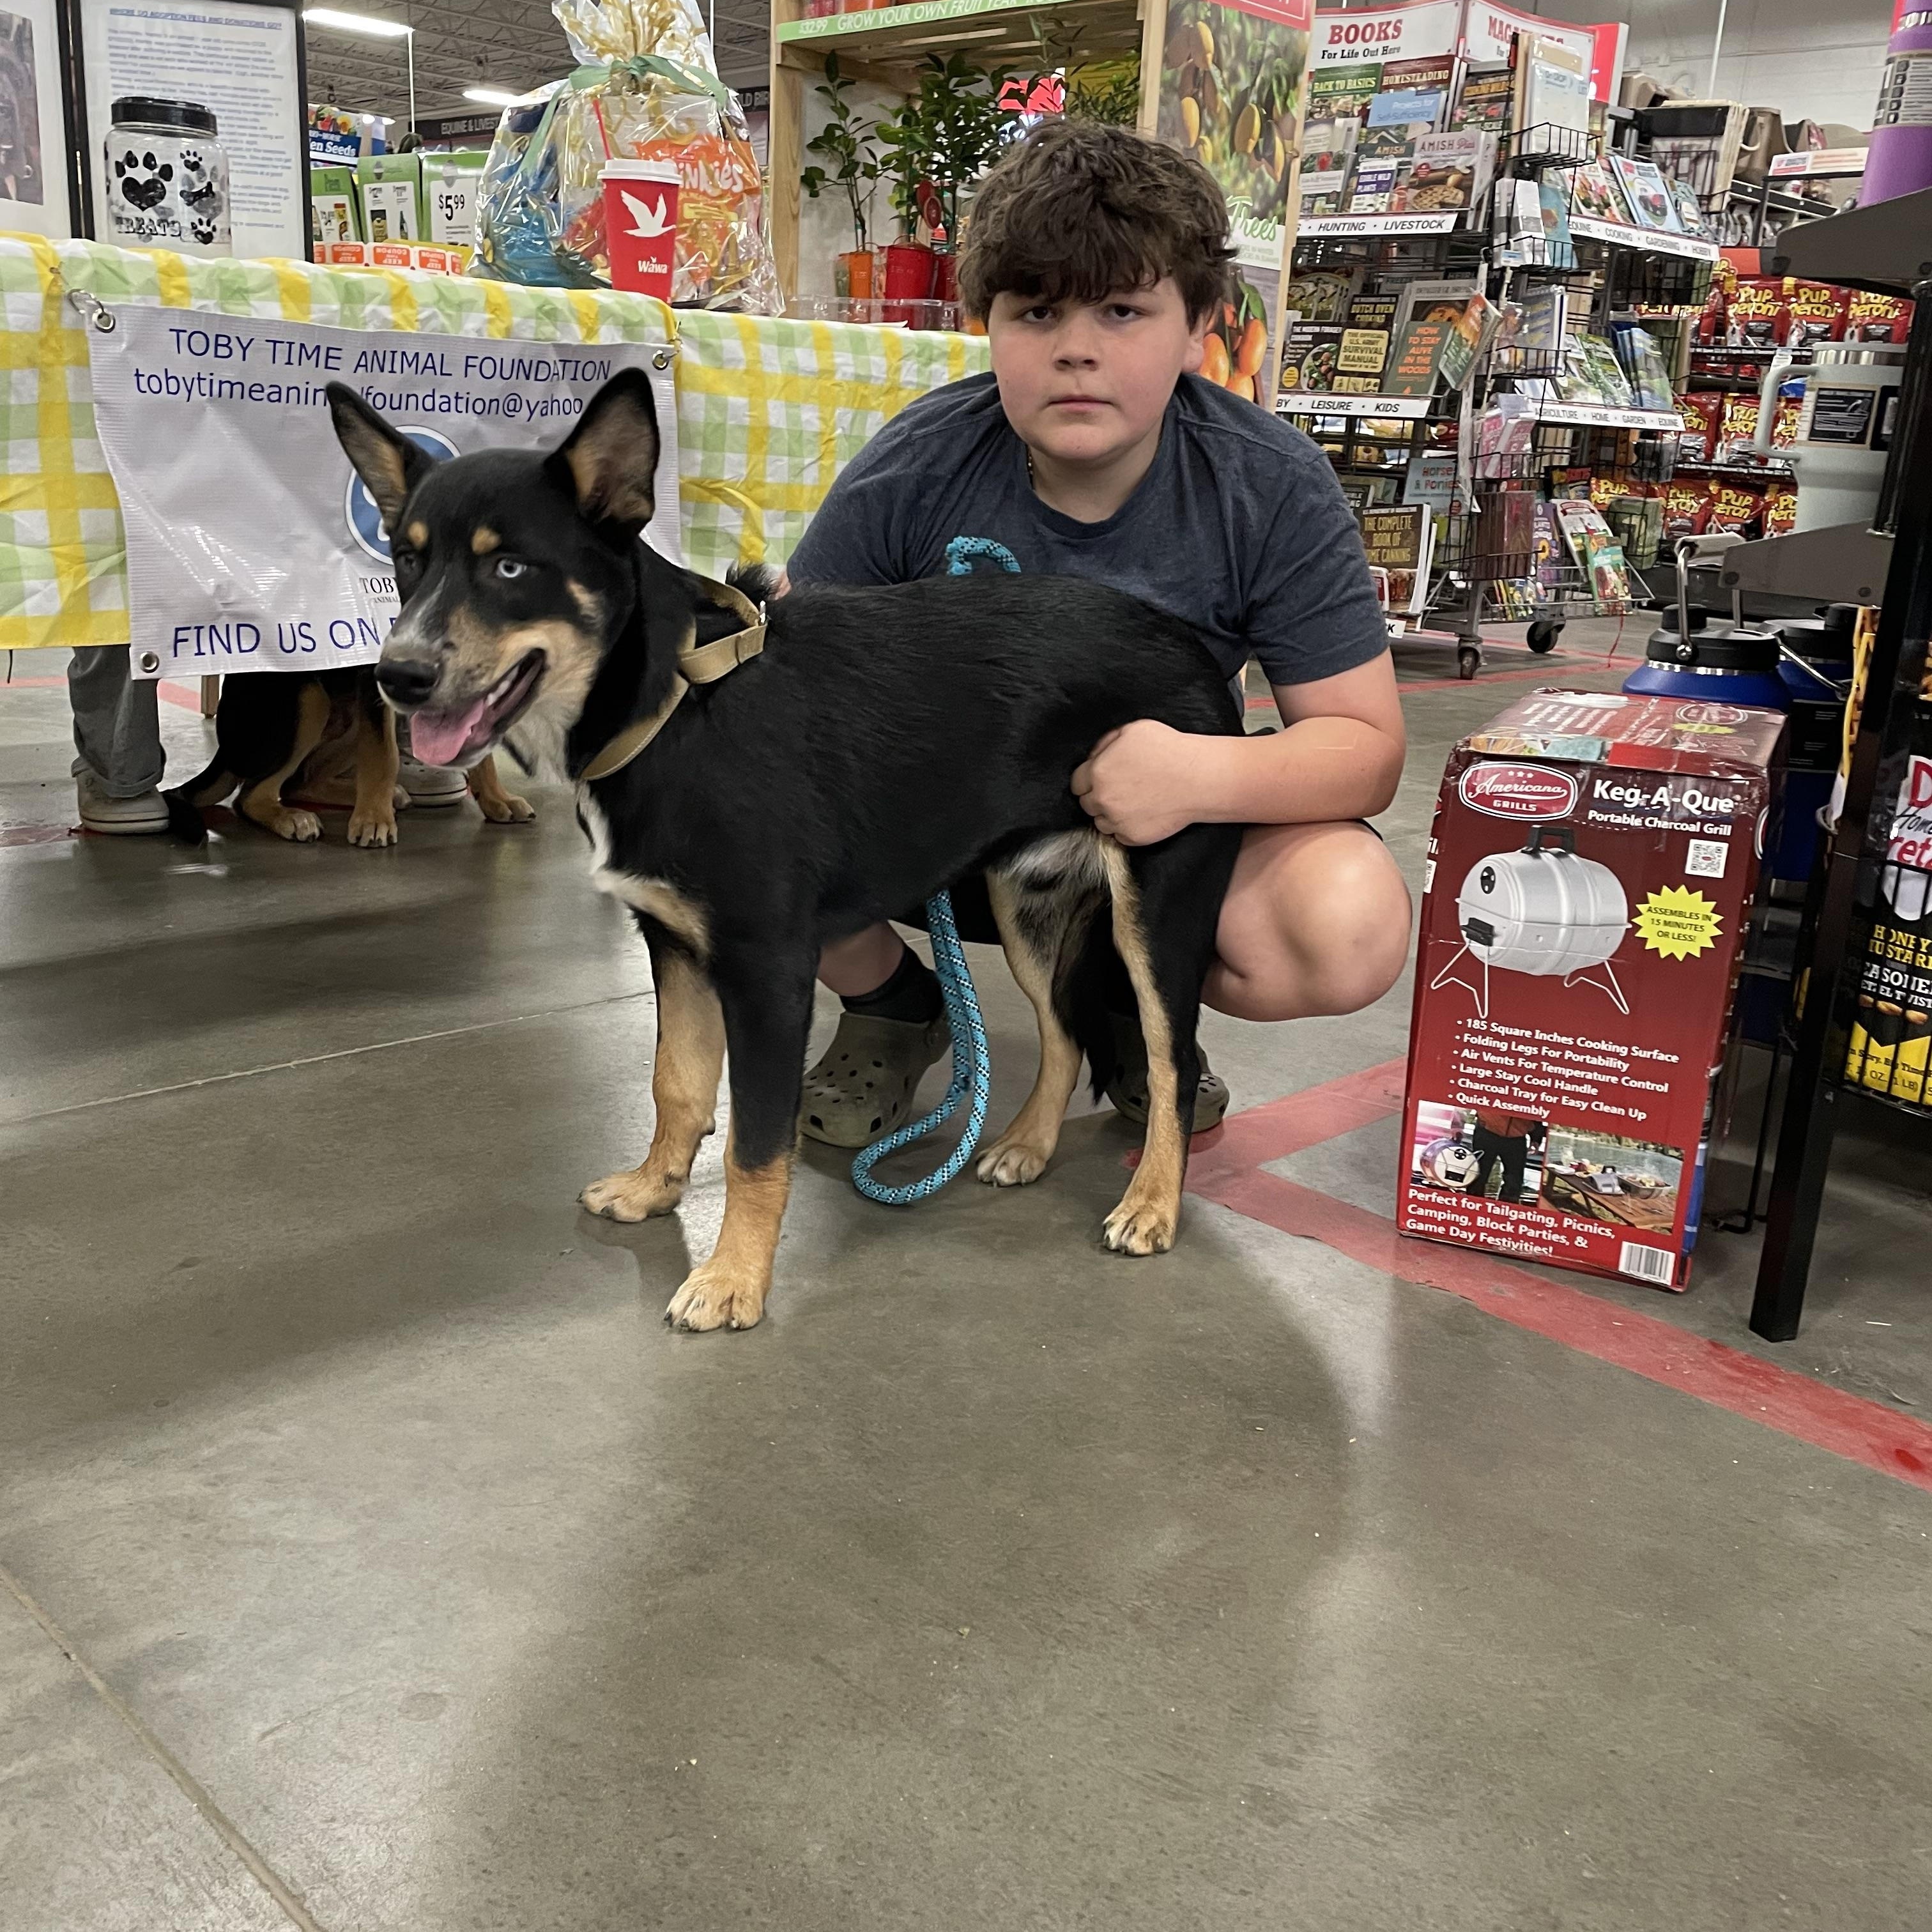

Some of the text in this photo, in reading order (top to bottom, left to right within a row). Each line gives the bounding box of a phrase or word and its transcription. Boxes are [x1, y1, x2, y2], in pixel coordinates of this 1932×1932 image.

[838, 12, 877, 31] GROW
[878, 7, 912, 25] YOUR
[914, 2, 947, 20] OWN
[1328, 19, 1404, 44] BOOKS
[1321, 45, 1400, 59] For Life Out Here
[1382, 70, 1449, 86] HOMESTEADING
[325, 141, 356, 157] Seeds
[1375, 146, 1406, 155] AMISH
[1420, 139, 1455, 152] AMISH
[1225, 195, 1278, 241] Trees
[1318, 219, 1446, 231] HUNTING LIVESTOCK
[1605, 227, 1633, 241] COOKING
[638, 258, 668, 273] Wawa
[169, 328, 611, 383] TOBY TIME ANIMAL FOUNDATION
[1342, 346, 1383, 355] SURVIVAL
[1344, 355, 1379, 364] MANUAL
[1311, 400, 1353, 411] LEISURE
[1374, 402, 1400, 413] KIDS
[1622, 415, 1646, 424] GARDEN
[1364, 515, 1413, 531] THE COMPLETE
[359, 577, 396, 594] TOB
[172, 618, 381, 657] FIND US ON
[1468, 773, 1568, 801] Americana
[1492, 799, 1537, 812] GRILLS
[1593, 779, 1734, 816] Keg-A-Que
[1588, 809, 1732, 836] Portable Charcoal Grill
[1646, 906, 1700, 920] ASSEMBLES
[1662, 920, 1705, 932] MINUTES
[1657, 930, 1696, 942] OR LESS!
[1466, 1018, 1680, 1064] 185 Square Inches Cooking Surface
[1463, 1033, 1630, 1073] Folding Legs For Portability
[1460, 1048, 1669, 1093] Air Vents For Temperature Control
[1459, 1063, 1598, 1096] Large Stay Cool Handle
[1456, 1092, 1551, 1119] Quick Assembly
[1457, 1077, 1646, 1121] Charcoal Tray for Easy Clean Up
[1408, 1188, 1458, 1207] Perfect
[1460, 1197, 1483, 1211] for
[1563, 1217, 1616, 1239] Picnics,
[1406, 1218, 1554, 1257] Game Day Festivities!
[1476, 1216, 1515, 1234] Block
[1518, 1224, 1570, 1246] Parties,
[1574, 1236, 1589, 1248] &
